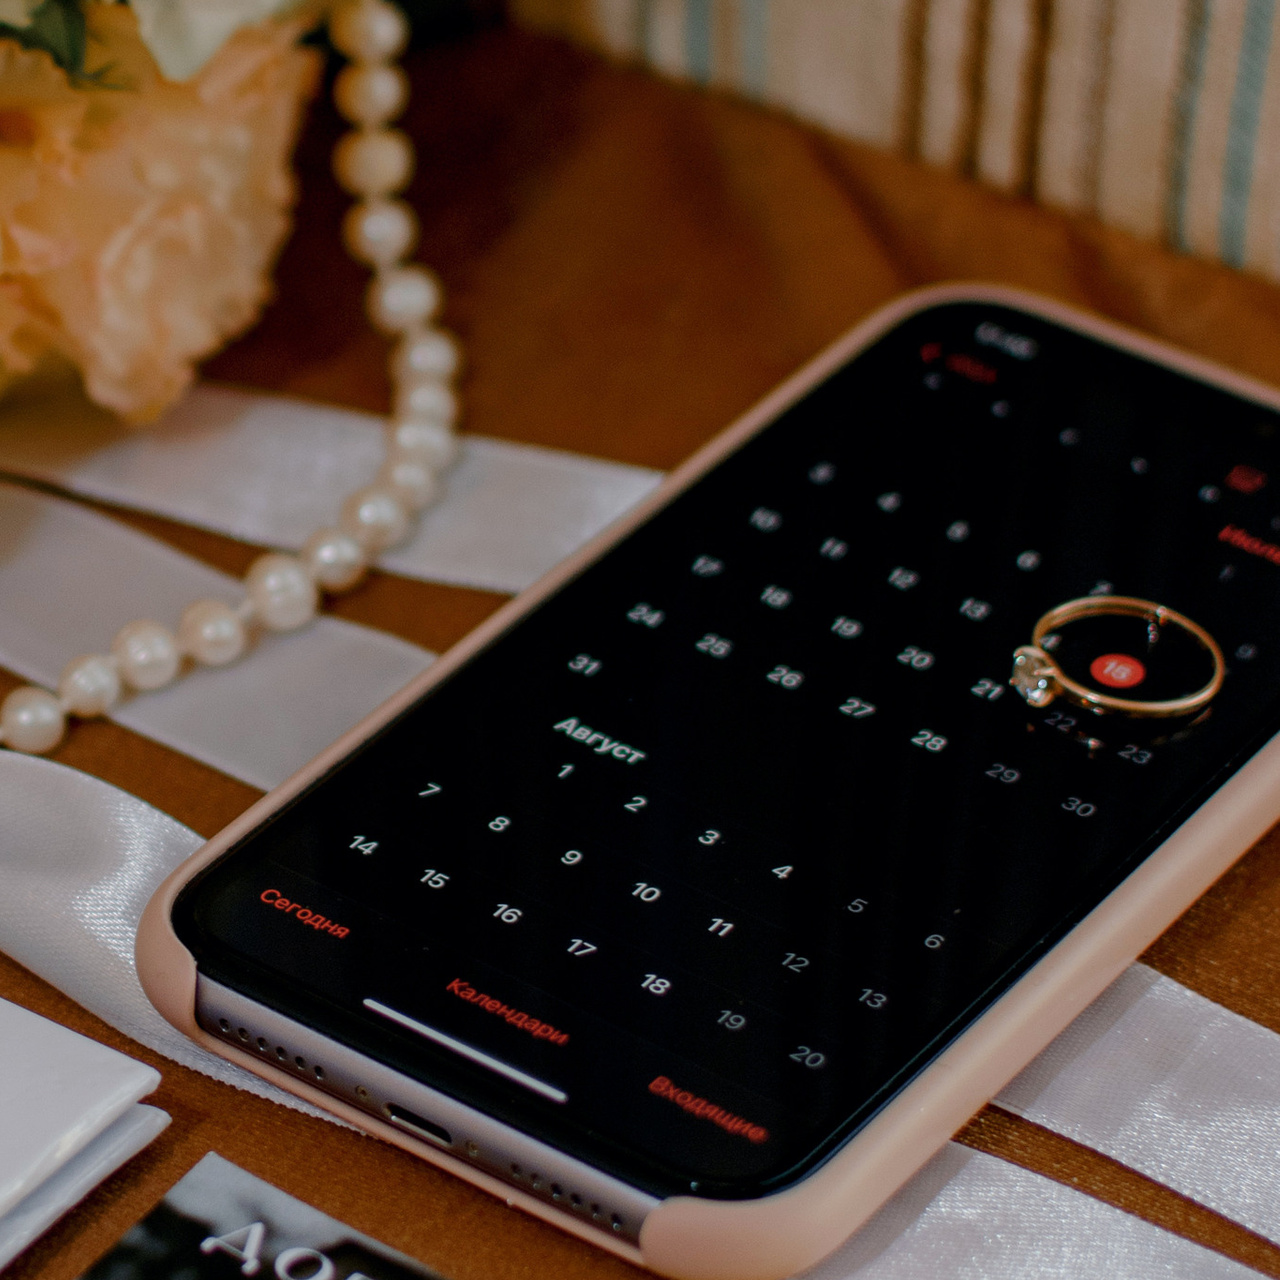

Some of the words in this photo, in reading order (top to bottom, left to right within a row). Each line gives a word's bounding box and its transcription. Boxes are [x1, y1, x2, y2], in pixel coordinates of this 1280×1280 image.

[553, 717, 647, 764] Август
[568, 655, 601, 676] 31
[627, 604, 663, 628] 24
[695, 634, 731, 658] 25
[766, 665, 803, 689] 26
[839, 697, 876, 718] 27
[910, 729, 948, 752] 28
[986, 763, 1020, 783] 29
[1061, 797, 1097, 817] 30
[831, 617, 862, 638] 19
[897, 646, 934, 670] 20
[971, 678, 1005, 700] 21
[1118, 744, 1152, 765] 23
[349, 835, 379, 855] 14
[420, 868, 450, 889] 15
[492, 903, 523, 924] 16
[567, 938, 598, 956] 17
[640, 973, 672, 995] 18
[717, 1010, 747, 1030] 19
[789, 1045, 826, 1068] 20
[418, 782, 442, 797] 7
[488, 815, 511, 832] 8
[560, 849, 583, 866] 9
[631, 881, 662, 903] 10
[707, 917, 734, 937] 11
[781, 952, 810, 973] 12
[858, 988, 888, 1009] 13
[557, 764, 574, 778] 1
[623, 795, 648, 813] 2
[697, 829, 721, 846] 3
[771, 864, 794, 879] 4
[847, 898, 868, 913] 5
[924, 933, 945, 949] 6
[259, 888, 352, 939] Сегодня
[445, 977, 570, 1046] Календари
[647, 1075, 769, 1144] Входящие
